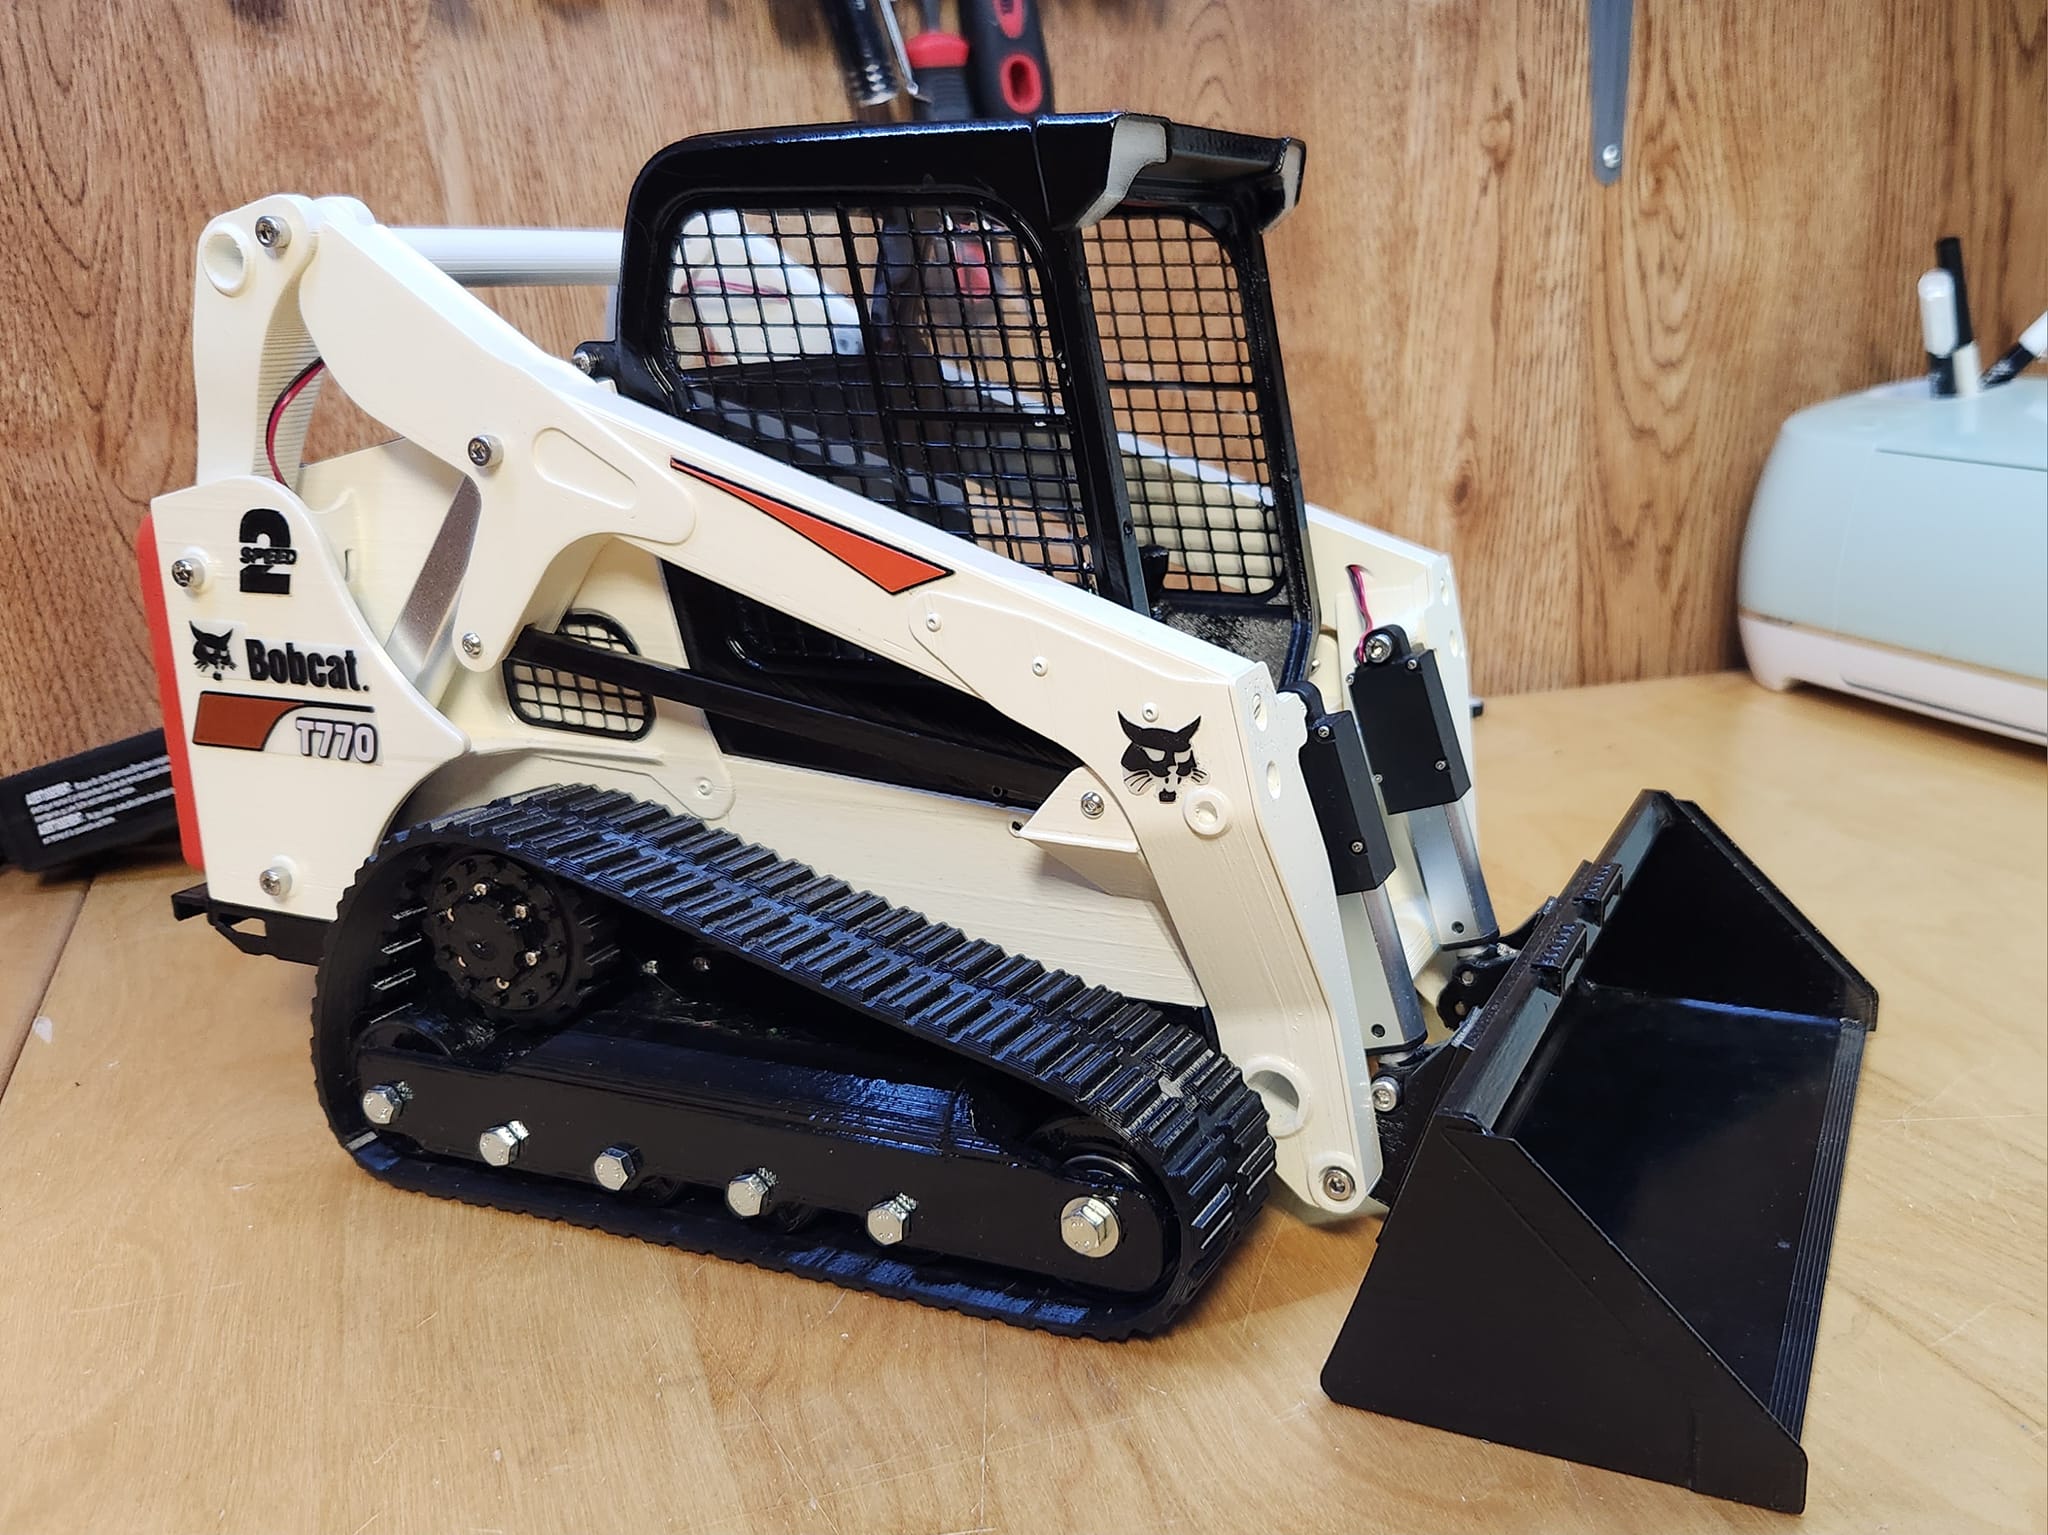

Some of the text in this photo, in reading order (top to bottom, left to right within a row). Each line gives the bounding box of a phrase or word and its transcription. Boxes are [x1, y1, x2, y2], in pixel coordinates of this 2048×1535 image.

[239, 508, 291, 594] 2
[240, 546, 297, 565] SPEED
[296, 717, 378, 764] T770
